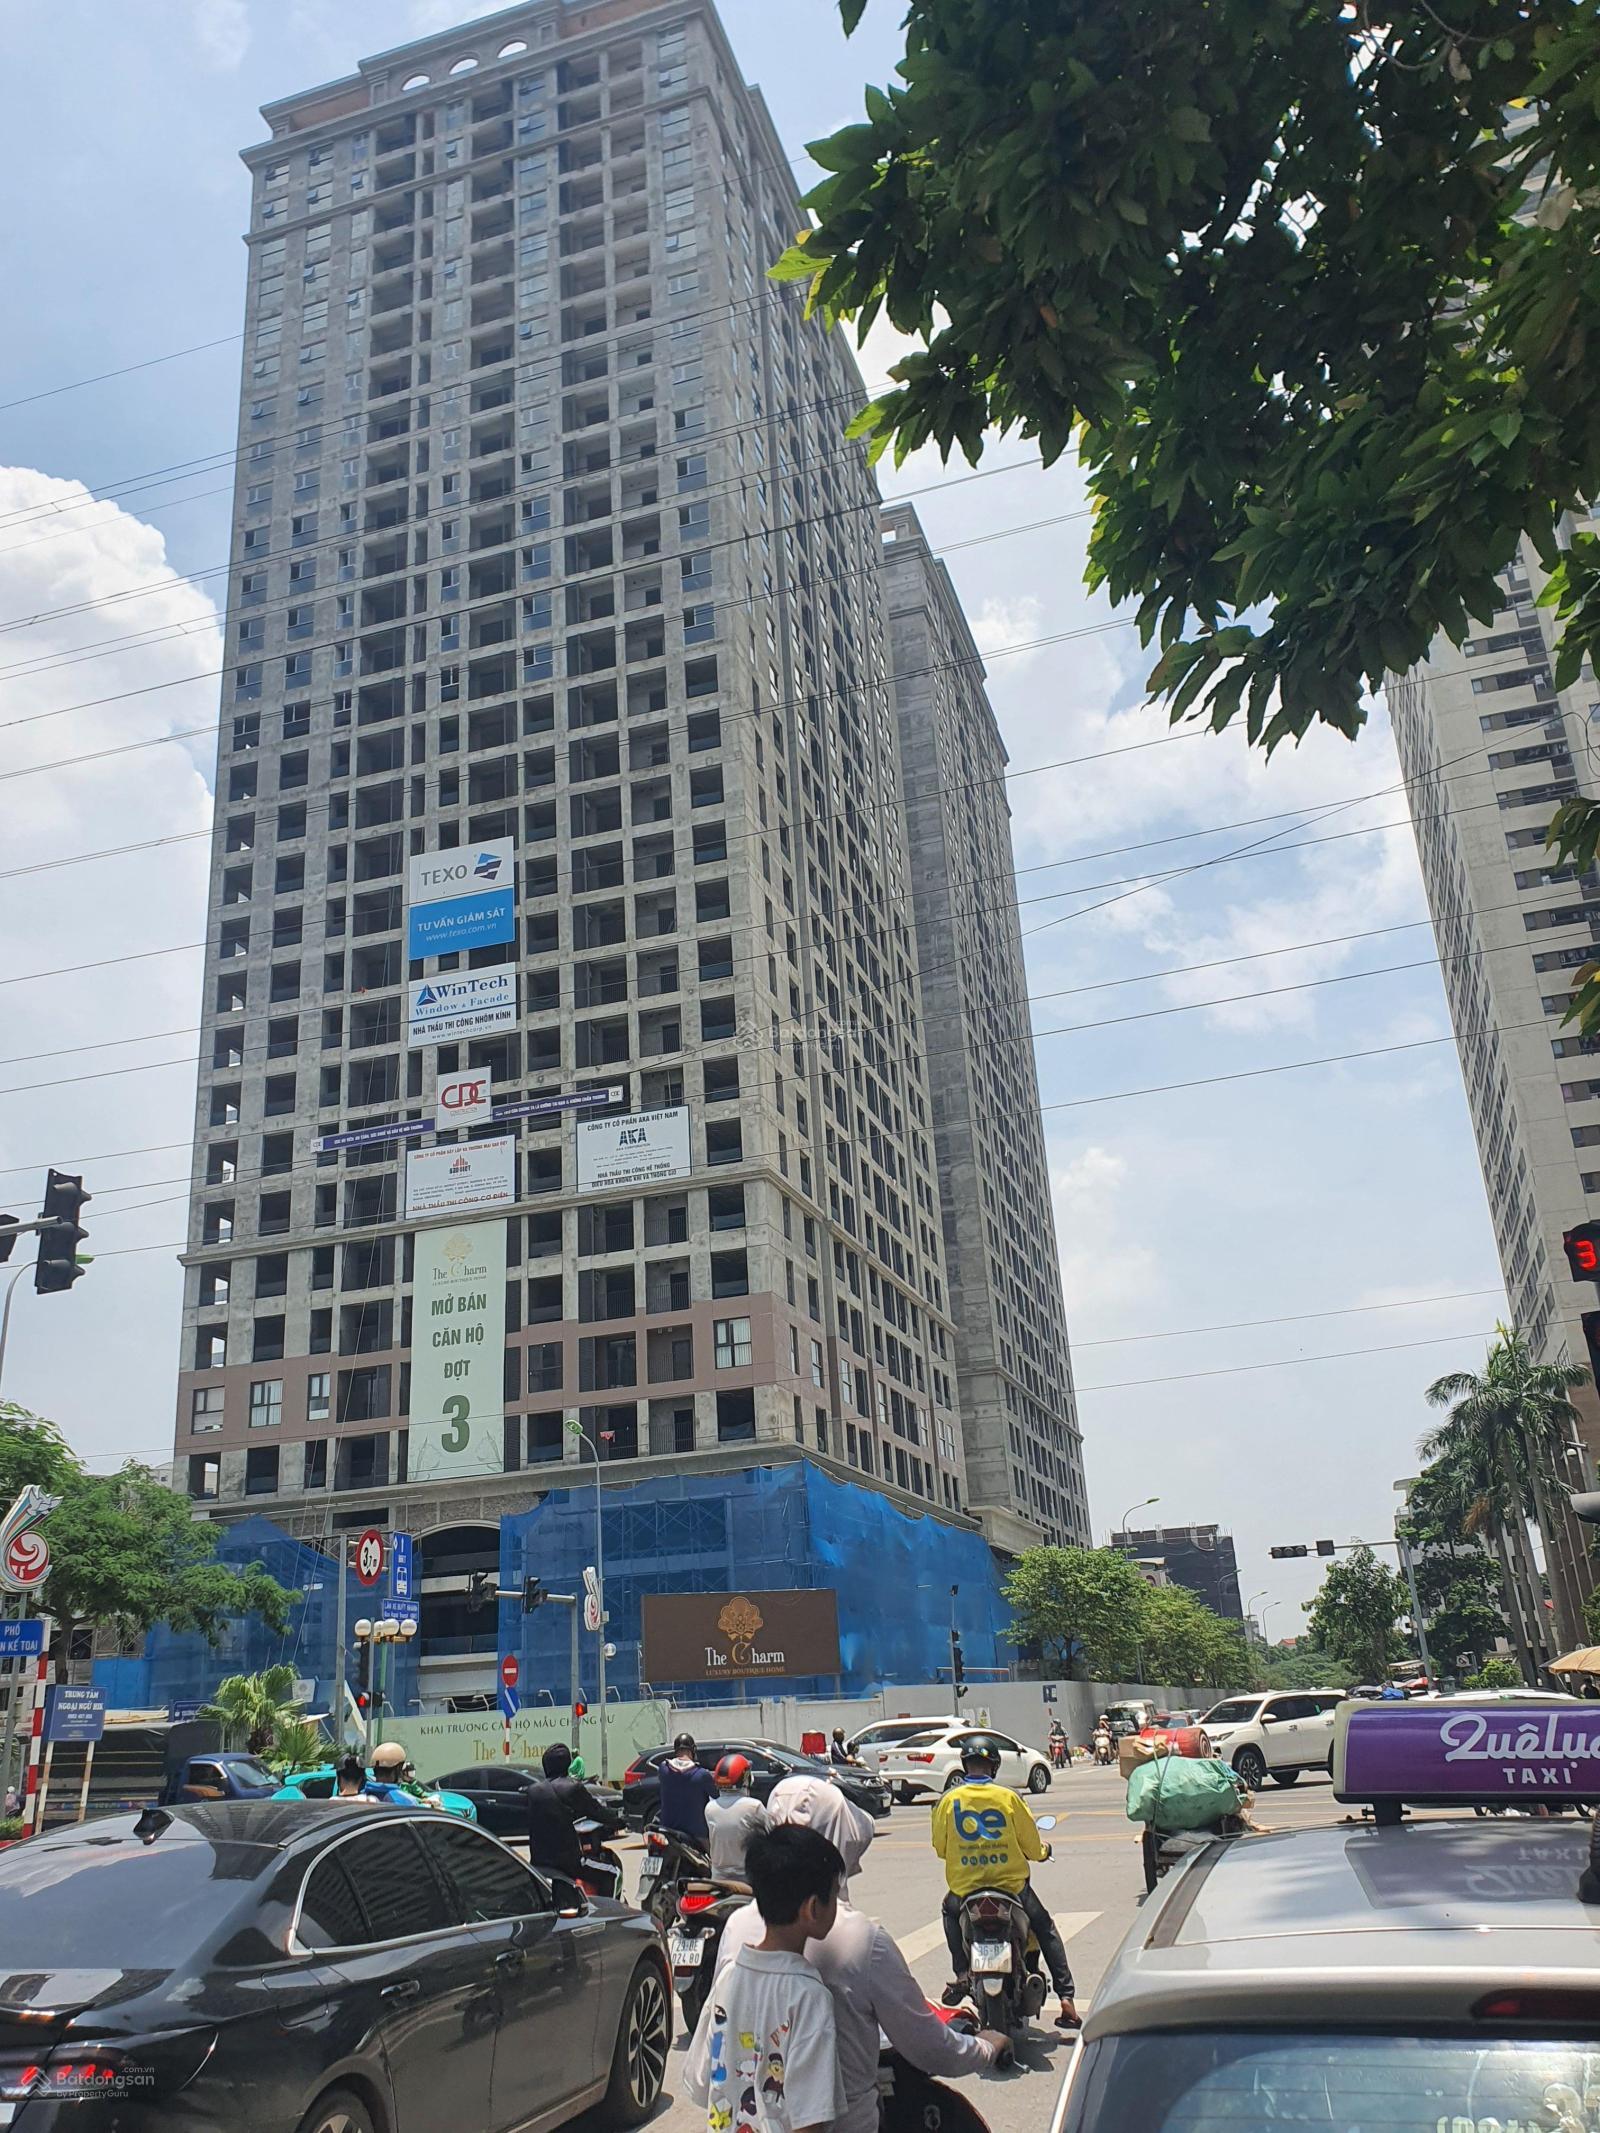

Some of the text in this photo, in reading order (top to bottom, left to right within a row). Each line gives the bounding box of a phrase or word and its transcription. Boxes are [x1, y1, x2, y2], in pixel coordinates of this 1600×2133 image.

[421, 865, 467, 886] TEXO
[418, 908, 506, 932] TƯ VẤN GIÁM SÁT
[426, 923, 496, 942] www.texo.com.vn
[436, 976, 508, 998] WinTech
[416, 1003, 457, 1016] Window
[470, 993, 509, 1006] Facade
[413, 1010, 510, 1036] NHÀ THẦU THI CÔNG NHÔM KÍNH
[588, 1123, 603, 1131] CÔNG
[621, 1117, 637, 1126] PHẦN
[620, 1128, 646, 1146] AKA
[609, 1169, 621, 1177] THẦU
[458, 1196, 478, 1204] CÔNG
[1575, 1241, 1598, 1270] 3
[432, 1262, 486, 1280] The Charm
[432, 1292, 486, 1316] MỞ BÁN
[433, 1323, 484, 1347] CĂN HỘ
[444, 1359, 470, 1380] ĐỢT
[442, 1395, 470, 1452] 3
[4, 1622, 20, 1636] PHỐ
[8, 1637, 19, 1651] KẾ
[21, 1641, 38, 1652] TOẠI
[705, 1642, 784, 1666] The Charm
[58, 1702, 78, 1711] NGOẠI
[421, 1726, 443, 1735] KHAI
[447, 1722, 489, 1733] TRƯƠNG
[515, 1720, 530, 1731] HỘ
[473, 1740, 496, 1760] The
[1503, 1768, 1571, 1784] TAXI
[954, 1799, 1007, 1841] be
